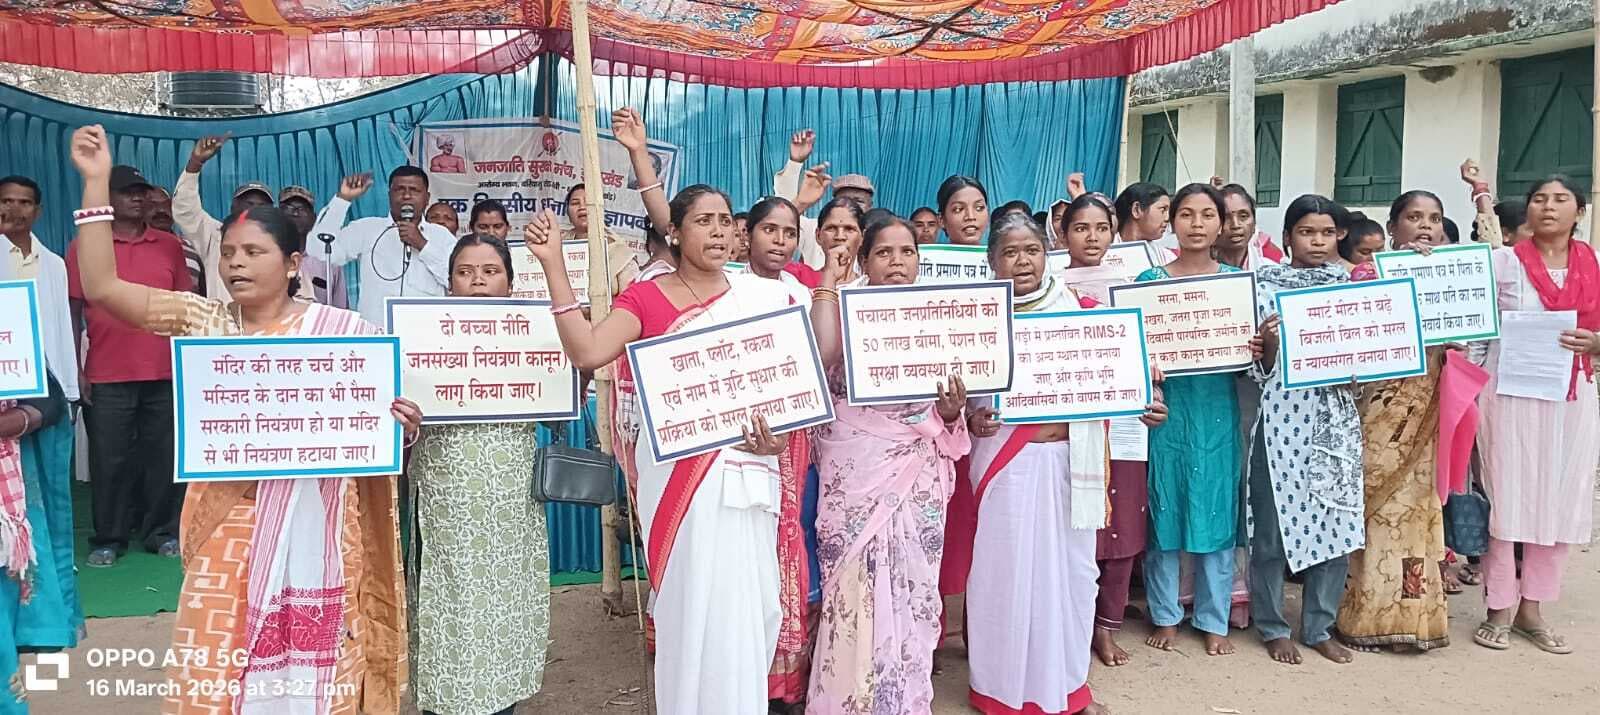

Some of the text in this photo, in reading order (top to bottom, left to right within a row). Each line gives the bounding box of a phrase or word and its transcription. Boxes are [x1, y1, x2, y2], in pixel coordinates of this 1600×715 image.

[474, 155, 525, 174] जनजाति
[936, 262, 961, 279] प्रमाण
[964, 264, 977, 279] पत्र
[979, 259, 989, 278] में
[1435, 264, 1446, 278] पत्र
[1456, 258, 1473, 277] पिता
[1474, 256, 1484, 274] के
[1157, 293, 1181, 305] सरना,
[1424, 291, 1440, 305] साथ
[1442, 284, 1456, 304] पति
[1458, 288, 1469, 303] का
[1471, 287, 1485, 301] नाम
[855, 297, 999, 324] पंचायत जनप्रतिनिधियों को
[1192, 309, 1210, 325] पूजा
[1213, 307, 1232, 319] स्थल
[1306, 300, 1332, 320] स्मार्ट
[1334, 299, 1359, 318] मीटर
[1443, 311, 1462, 329] किया
[439, 313, 530, 338] दो बच्चा नीति
[1044, 325, 1080, 342] प्रस्तावित
[1083, 323, 1127, 340] RIMS-2
[1145, 328, 1174, 345] दिवासी
[1299, 325, 1336, 347] बिजली
[1338, 325, 1361, 342] बिल
[1382, 321, 1406, 336] सरल
[863, 326, 997, 353] 50 लाख बीमा, पेंशन एवं
[212, 350, 366, 375] मंदिर की तरह चर्च और
[404, 346, 569, 375] जनसंख्या नियंत्रण कानून)
[669, 349, 706, 373] खाता,
[706, 338, 741, 364] प्लॉट,
[1035, 351, 1054, 363] अन्य
[1056, 349, 1079, 362] स्थान
[1081, 348, 1092, 361] पर
[1094, 347, 1121, 361] बनाया
[1180, 348, 1205, 364] कानून
[1207, 345, 1232, 358] बनाया
[1292, 345, 1417, 372] व न्यायसंगत बनाया जाए।
[661, 355, 799, 411] एवं नाम में त्रुटि सुधार की
[868, 364, 899, 387] सुरक्षा
[903, 361, 947, 379] व्यवस्था
[966, 359, 995, 378] जाए।
[1033, 365, 1115, 387] जाए और कृषि भूमि
[203, 379, 376, 405] मस्जिद के दान का भी पैसा
[434, 378, 543, 408] लागू किया जाए।
[1006, 389, 1058, 408] आदिवासियों
[1076, 391, 1101, 403] वापस
[200, 411, 381, 435] सरकारी नियंत्रण हो या मंदिर
[656, 419, 698, 446] प्रक्रिया
[698, 408, 719, 432] को
[719, 406, 749, 428] सरल
[787, 389, 820, 411] जाए।
[204, 443, 376, 465] से भी नियंत्रण हटाया जाए।
